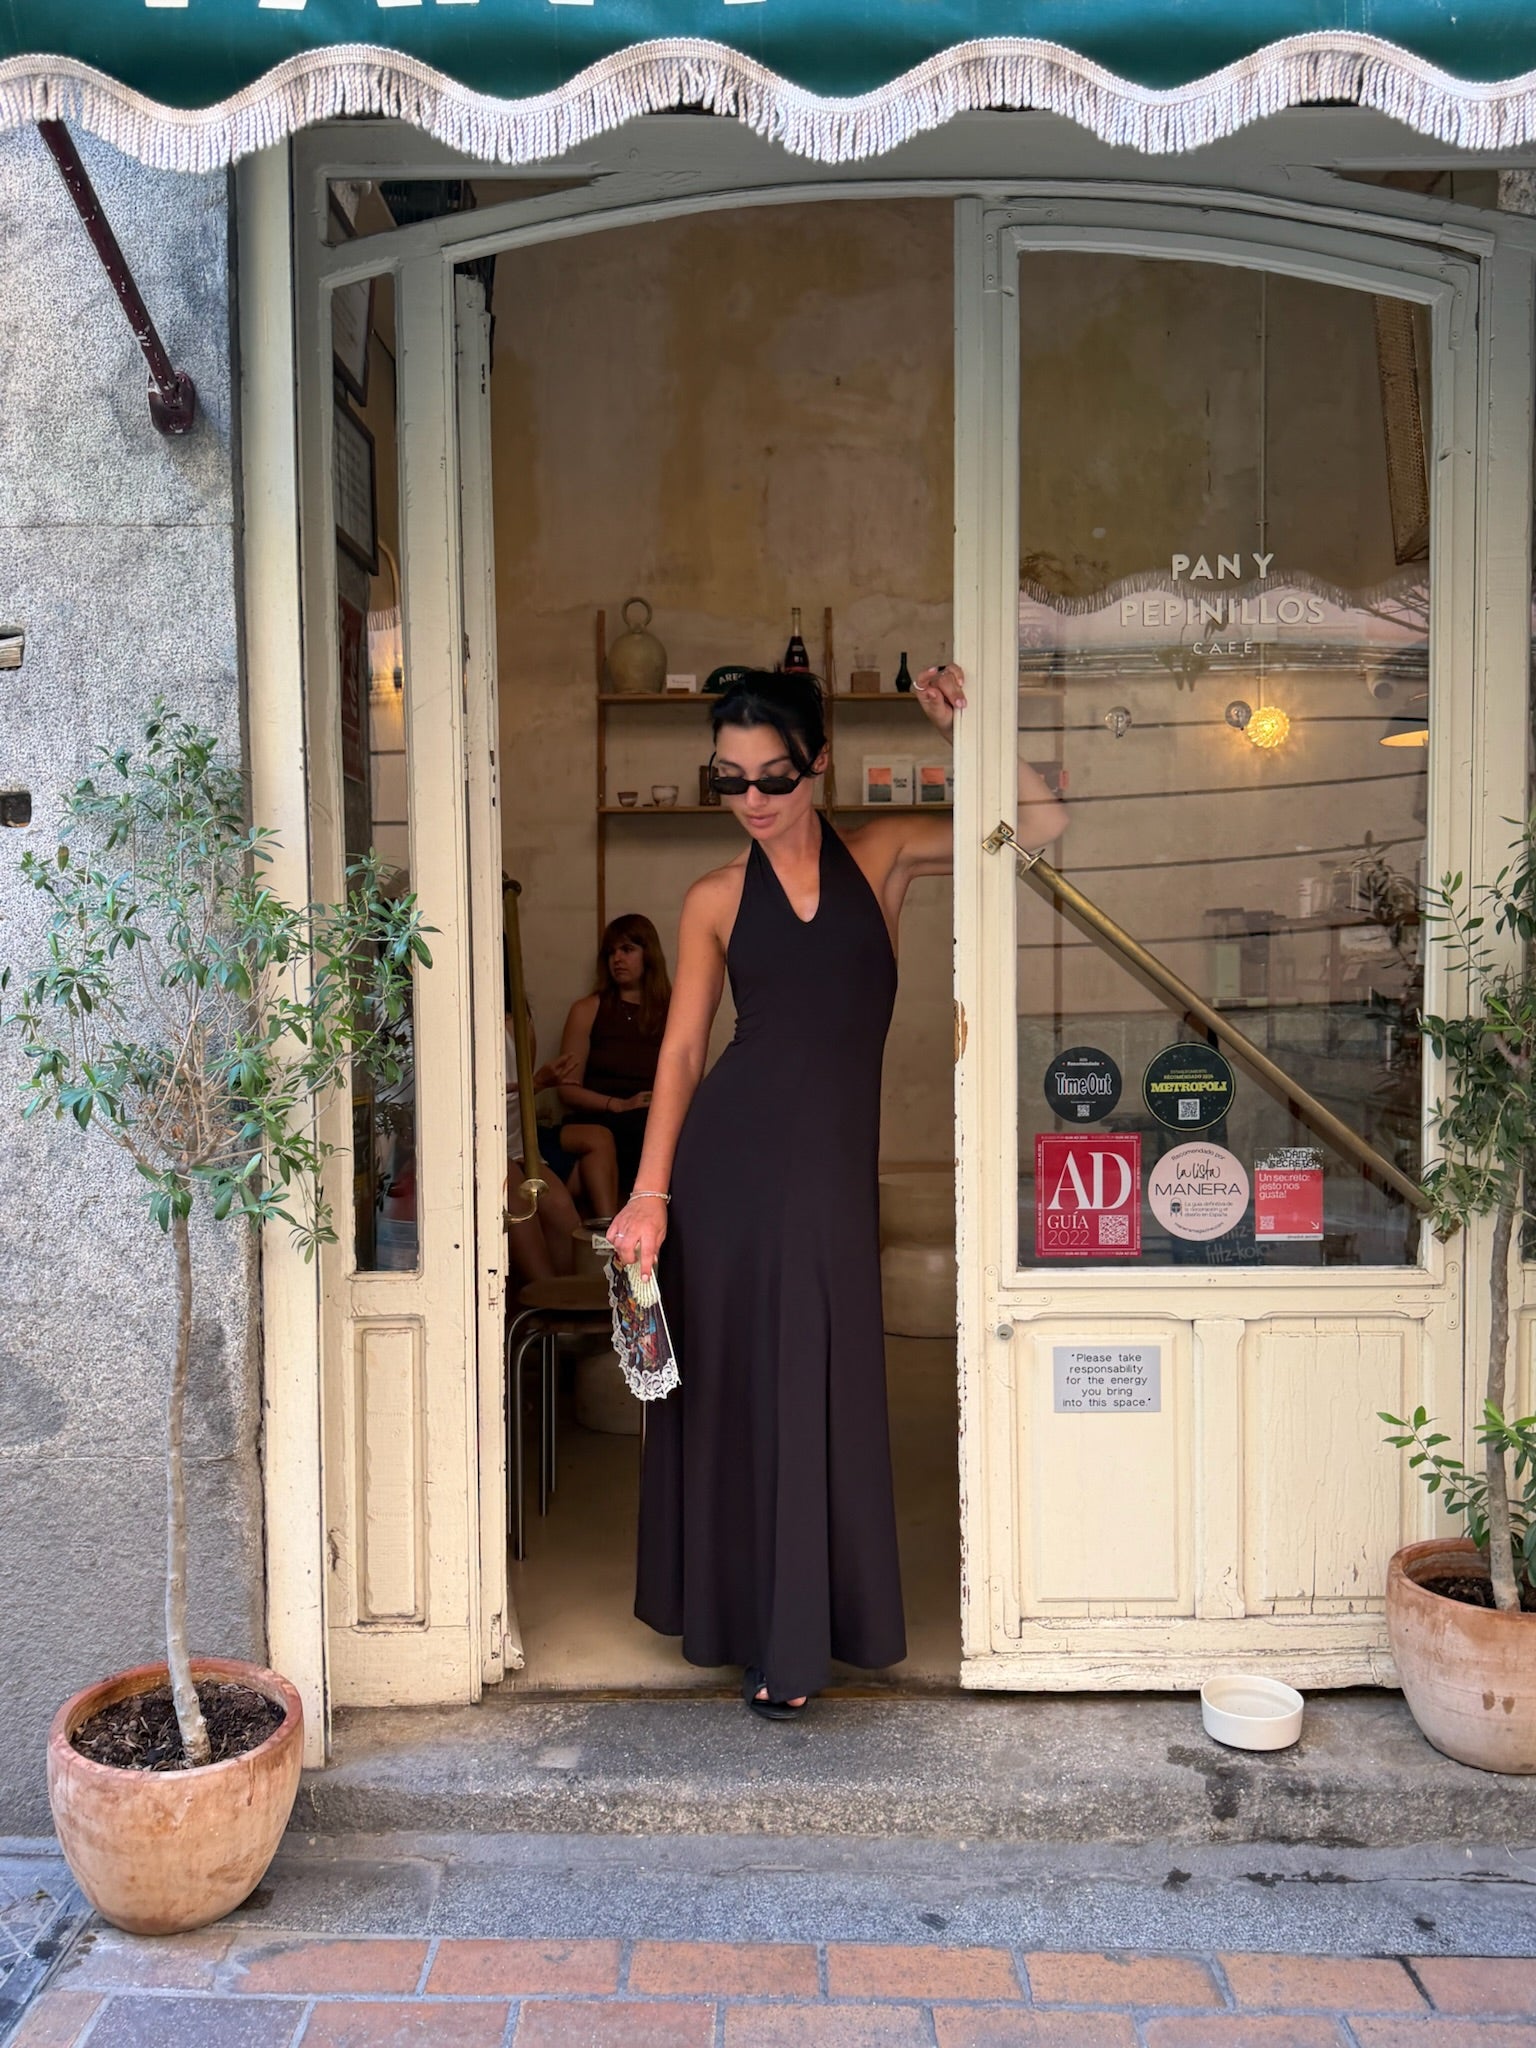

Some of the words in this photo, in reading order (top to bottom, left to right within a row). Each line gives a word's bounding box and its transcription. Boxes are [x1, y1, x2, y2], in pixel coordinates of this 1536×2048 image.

[1171, 553, 1241, 581] PAN
[1252, 552, 1274, 579] Y
[1120, 597, 1325, 627] PEPINILLOS
[1192, 637, 1253, 655] CAFÉ
[1150, 1081, 1227, 1093] METROPOLI
[1047, 1151, 1132, 1210] AD
[1259, 1173, 1272, 1182] Un
[1155, 1183, 1242, 1196] MANERA
[1047, 1211, 1089, 1229] GUÍA
[1048, 1230, 1090, 1246] 2022
[1118, 1353, 1142, 1362] take
[1069, 1365, 1143, 1375] responsability
[1066, 1376, 1081, 1385] for
[1088, 1376, 1104, 1385] the
[1111, 1376, 1148, 1386] energy
[1081, 1388, 1102, 1398] you
[1106, 1387, 1133, 1397] bring
[1062, 1398, 1082, 1407] into
[1089, 1398, 1107, 1407] this
